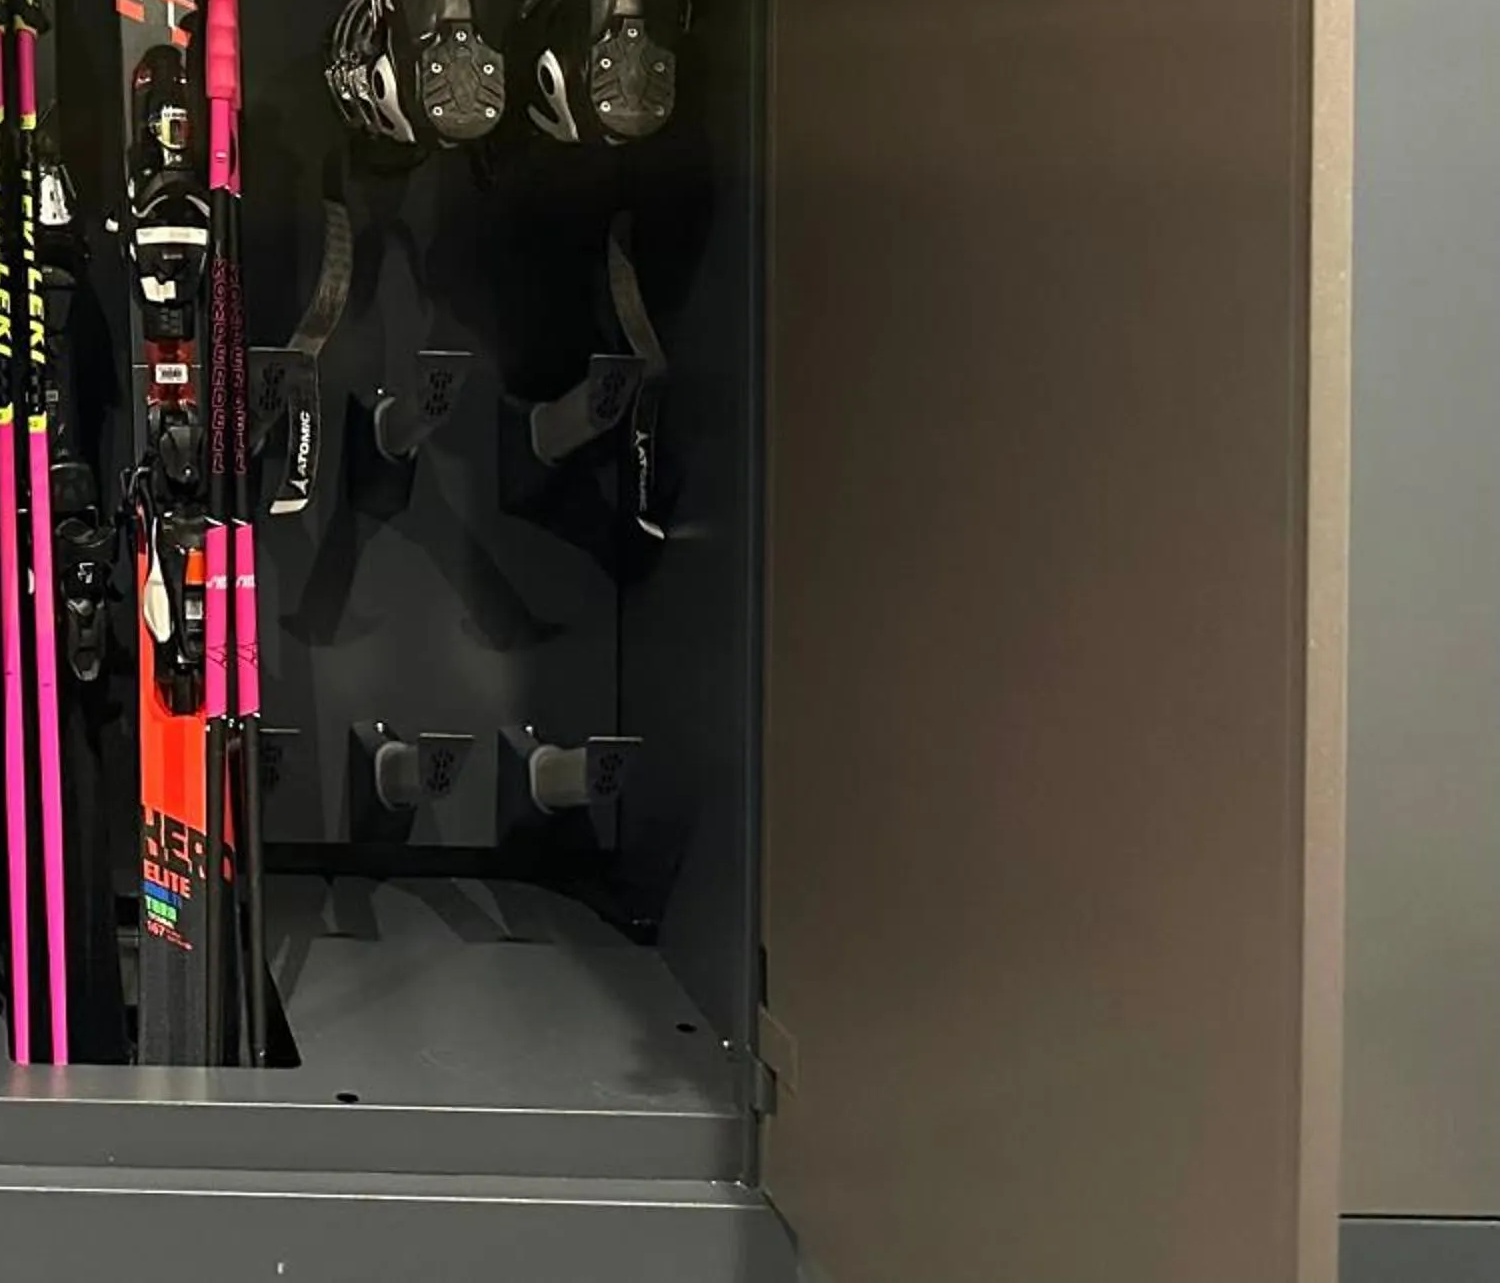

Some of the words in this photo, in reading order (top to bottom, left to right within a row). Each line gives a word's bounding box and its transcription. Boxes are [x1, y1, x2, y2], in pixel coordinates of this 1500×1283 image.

[27, 266, 46, 365] LEKI
[296, 409, 311, 478] ATOMIC
[142, 859, 192, 899] ELITE
